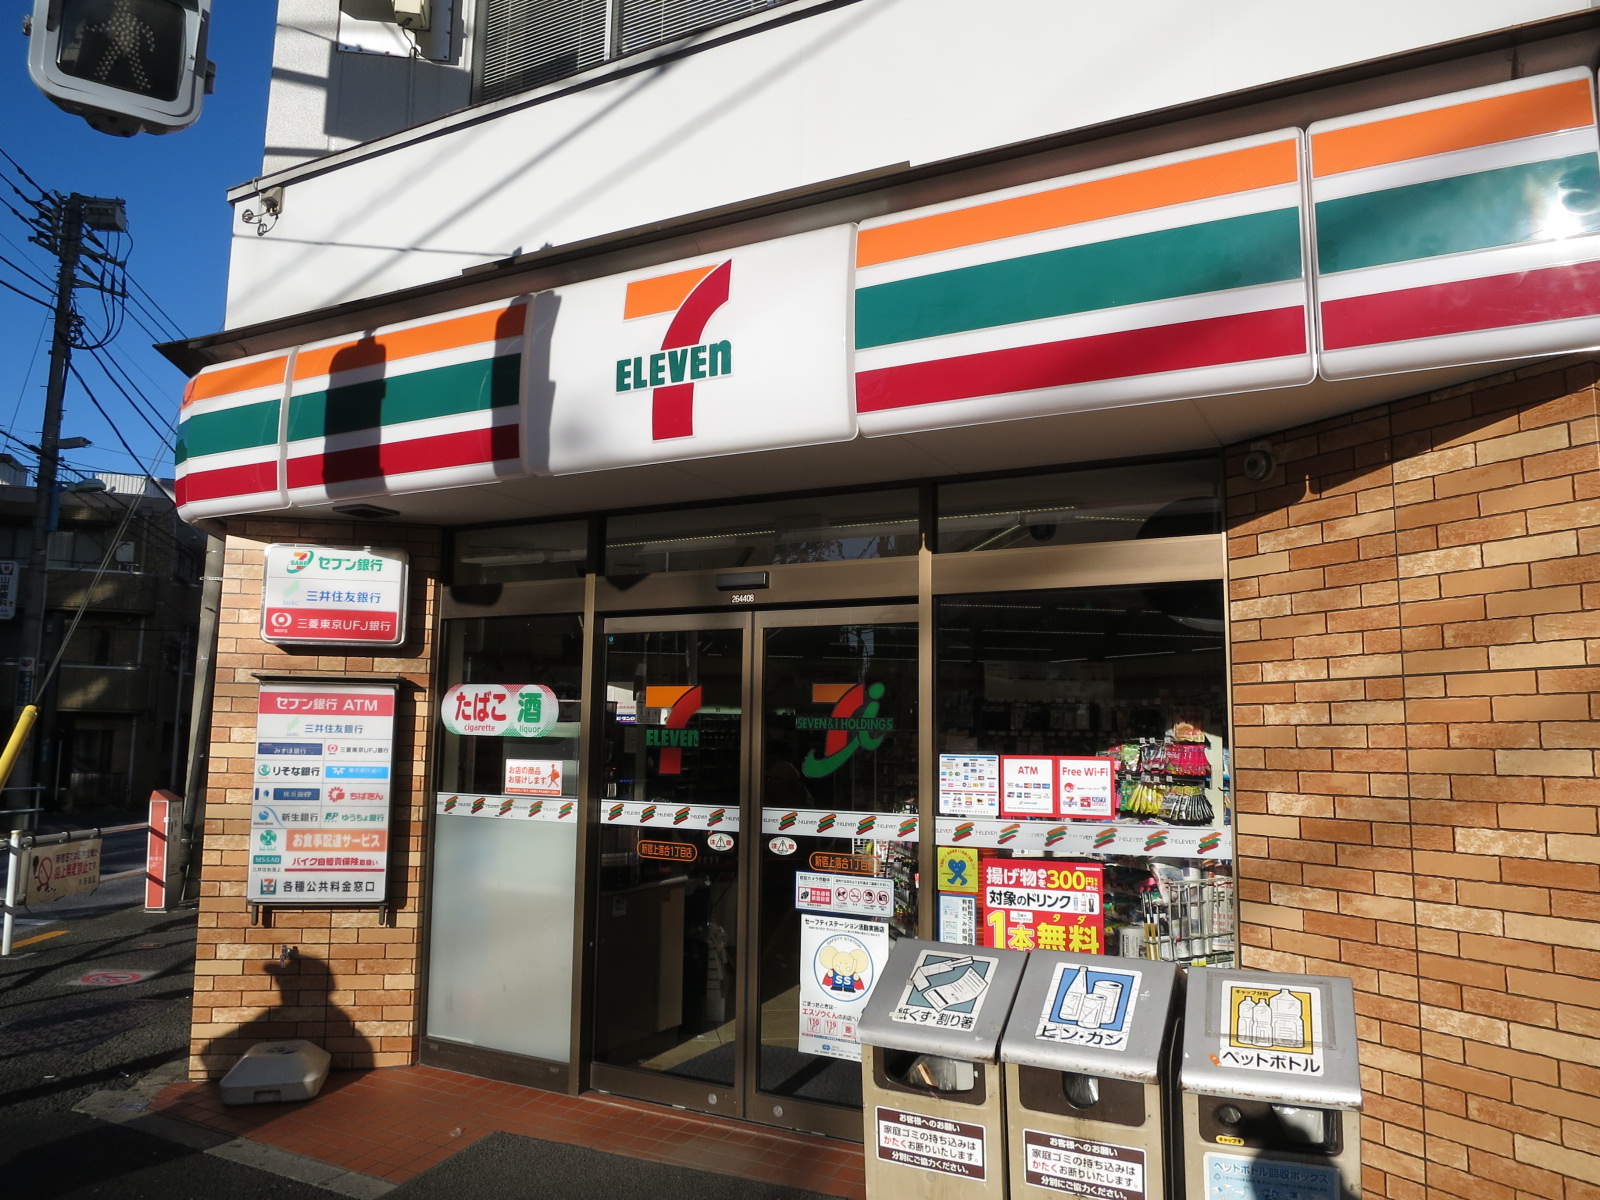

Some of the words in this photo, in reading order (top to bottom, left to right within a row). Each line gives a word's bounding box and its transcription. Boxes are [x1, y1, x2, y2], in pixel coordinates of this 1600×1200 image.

[319, 556, 383, 572] セブン銀行
[306, 591, 381, 604] 三井住友銀行
[731, 594, 755, 603] 264408
[297, 618, 391, 632] 三菱東京UFJ銀行
[276, 697, 338, 711] セブン銀行
[343, 699, 378, 711] ATM
[455, 691, 507, 722] たばこ
[517, 692, 542, 723] 酒
[305, 724, 364, 734] 三井住友銀行
[464, 724, 496, 732] cigarette
[519, 725, 541, 734] liquor
[841, 718, 893, 730] HOLDINGS
[274, 747, 307, 755] みずほ銀行
[340, 746, 389, 754] 三菱東京UFJ銀行
[273, 766, 320, 777] りそな銀行
[509, 766, 541, 775] お店の商品
[1018, 766, 1038, 775] ATM
[1062, 767, 1082, 776] Free
[1084, 768, 1109, 777] Wi-Fi
[281, 812, 319, 822] 新生銀行
[342, 813, 384, 822] ゆうちょ銀行
[293, 833, 381, 848] お食事配達サービス
[641, 843, 693, 858] 新宿上落合1丁目店
[283, 881, 375, 893] 各種公共料金窓口
[989, 890, 1071, 909] 対象のドリンク
[805, 918, 885, 933] セーフティステーション活動実施店
[835, 976, 851, 985] SS
[1222, 1051, 1320, 1073] ペットボトル
[899, 1114, 960, 1132] お客様へのお願い
[883, 1124, 976, 1151] 家庭ゴミの持ち込みは
[883, 1136, 979, 1163] かたくお断りいたします。
[1049, 1137, 1118, 1156] お客様へのお願い
[891, 1150, 970, 1174] 分別にご協力ください。
[1032, 1148, 1136, 1175] 家庭ゴミの持ち込みは
[1032, 1159, 1139, 1189] かたくお断りいたします。
[1213, 1162, 1329, 1184] ペットボトル回収ボックス
[1041, 1175, 1128, 1200] 分別にご協力ください。
